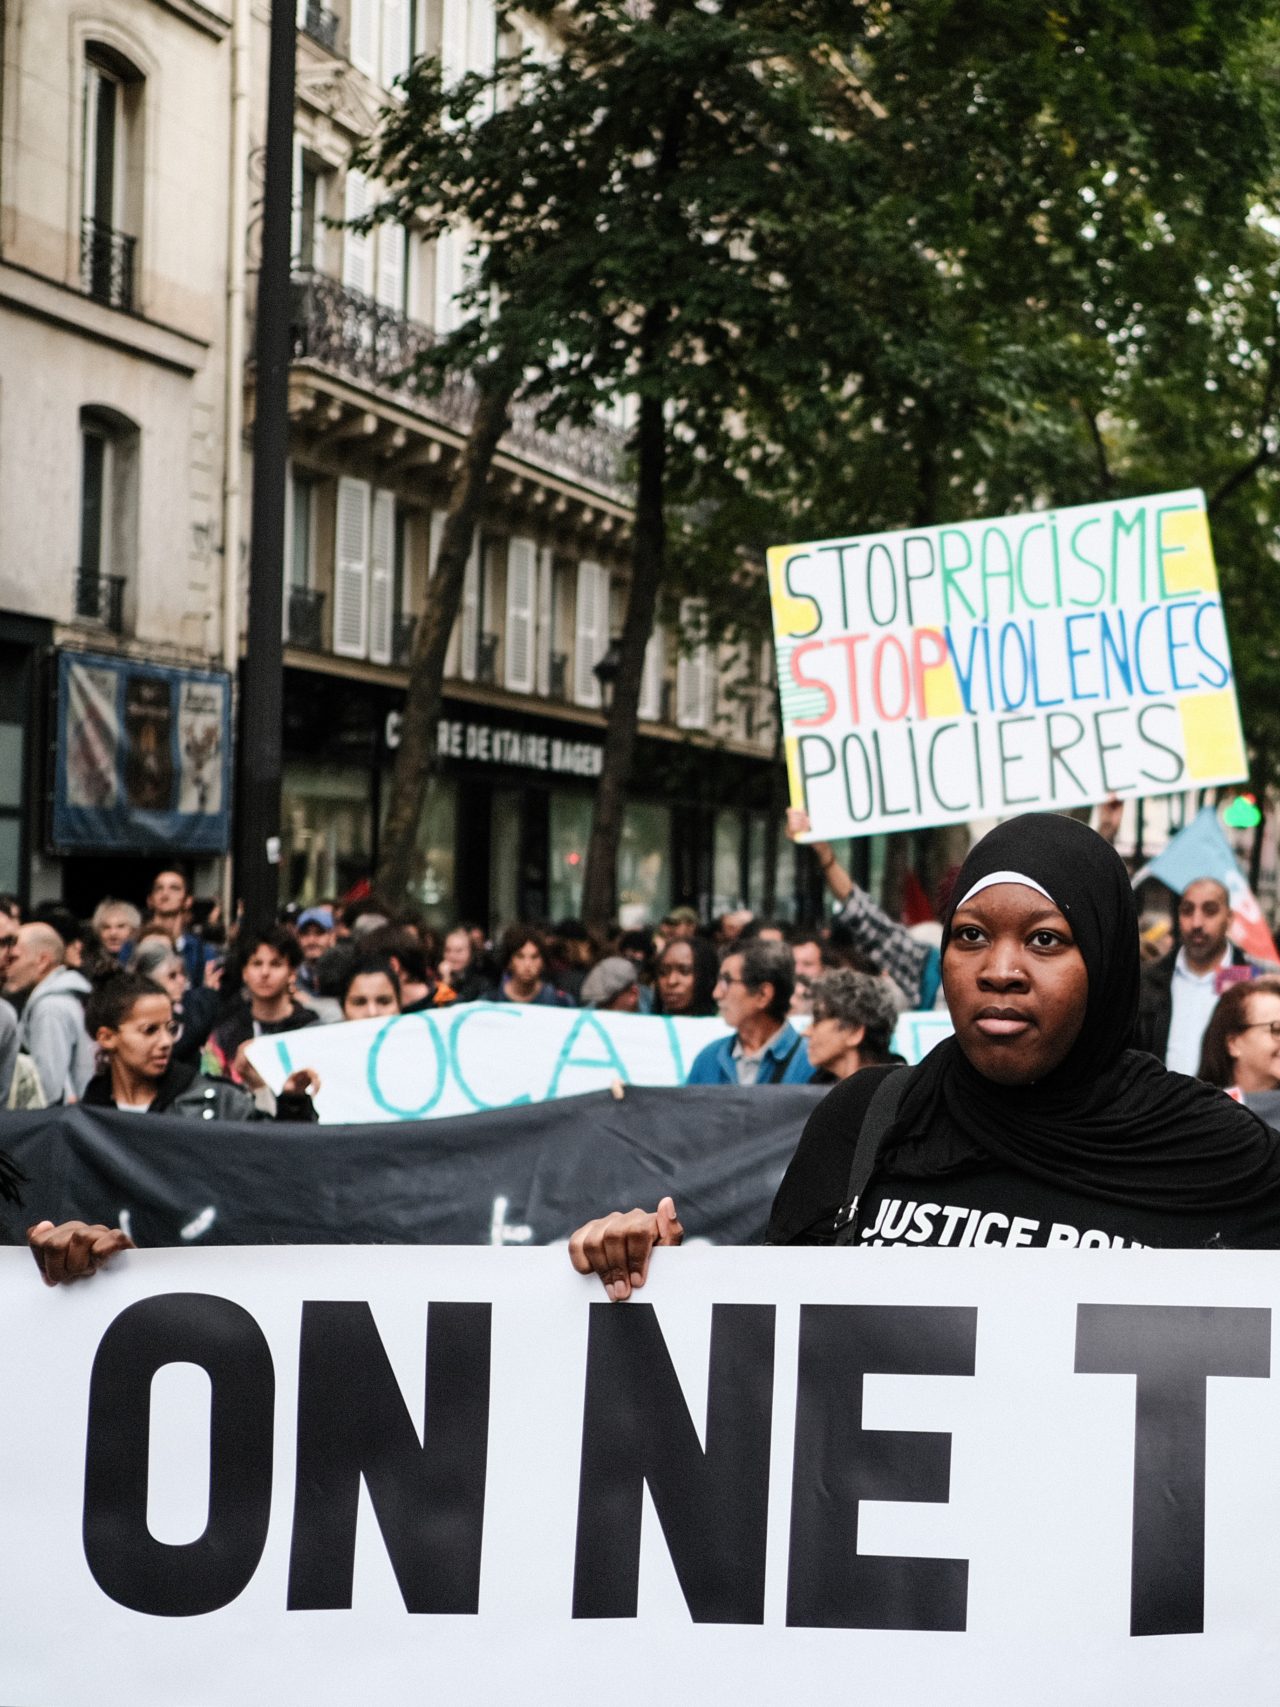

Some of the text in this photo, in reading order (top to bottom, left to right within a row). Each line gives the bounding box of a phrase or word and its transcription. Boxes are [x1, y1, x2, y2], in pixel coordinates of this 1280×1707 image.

[785, 535, 935, 638] STOP
[790, 628, 949, 726] STOP
[385, 711, 463, 757] CRE
[861, 1199, 1040, 1248] JUSTICE
[82, 1292, 493, 1617] ON
[571, 1301, 978, 1632] NE
